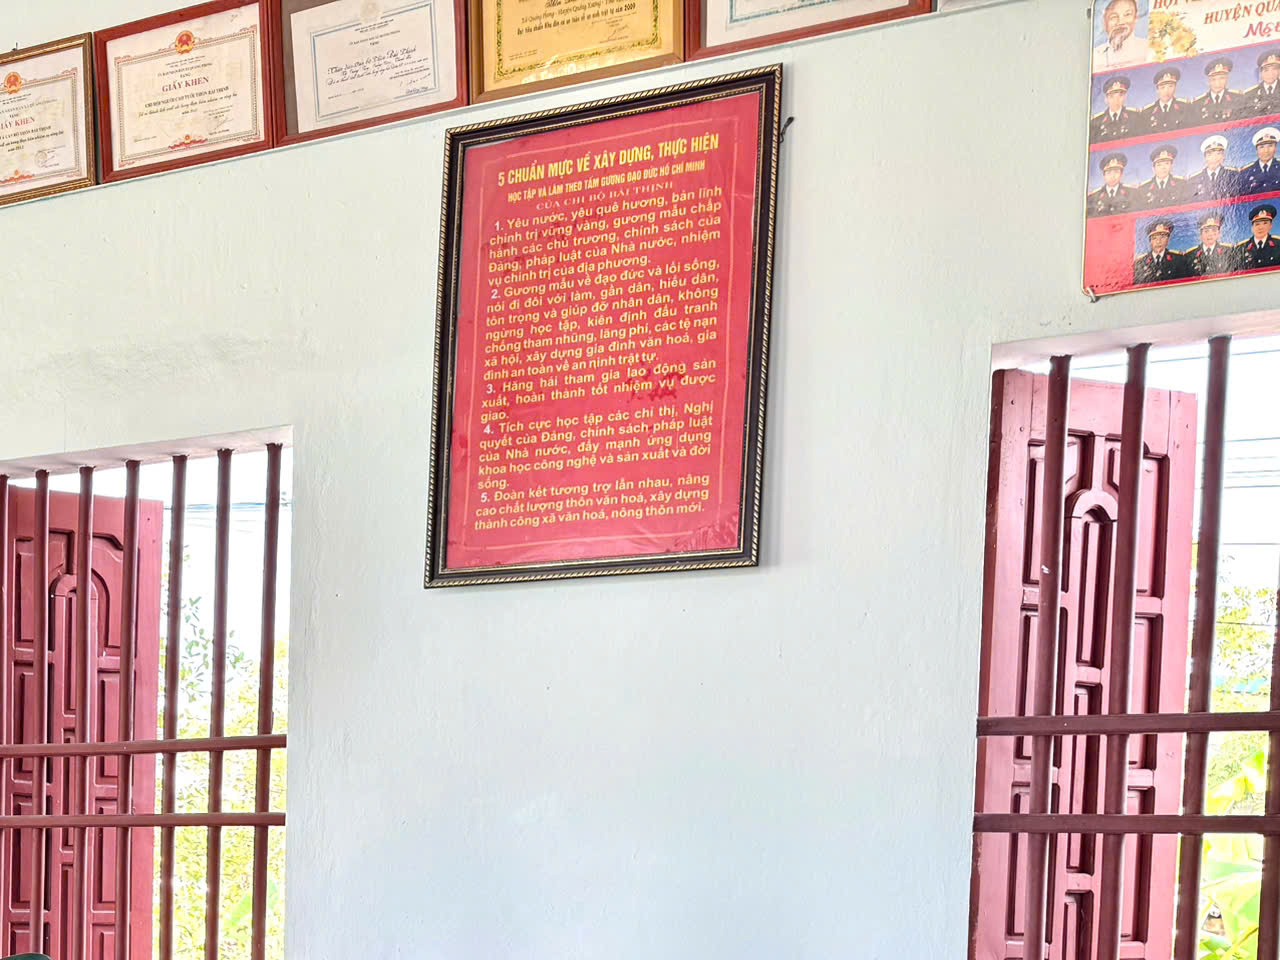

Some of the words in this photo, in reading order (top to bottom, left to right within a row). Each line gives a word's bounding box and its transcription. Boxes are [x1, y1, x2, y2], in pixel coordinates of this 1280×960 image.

[1203, 3, 1253, 24] HUYỆN
[162, 80, 182, 93] GIẤY
[184, 76, 210, 88] KHEN
[14, 116, 36, 127] KHEN
[497, 171, 505, 187] 5
[507, 159, 545, 185] CHUẨN
[547, 158, 574, 179] MỰC
[576, 151, 591, 173] VỀ
[593, 149, 617, 170] XÂY
[618, 144, 655, 166] DỰNG,
[657, 137, 688, 159] THỰC
[690, 131, 720, 154] HIỆN
[507, 191, 522, 204] HỌC
[523, 187, 537, 201] TẬP
[537, 185, 547, 198] VÀ
[547, 183, 564, 196] LÀM
[564, 180, 583, 193] THEO
[584, 177, 600, 190] TẤM
[600, 172, 626, 187] GƯƠNG
[626, 170, 642, 184] ĐẠO
[642, 167, 659, 180] ĐỨC
[659, 163, 670, 177] HỒ
[671, 161, 684, 175] CHÍ
[684, 159, 706, 173] MINH
[489, 231, 522, 246] chính
[525, 228, 538, 241] trị
[541, 224, 573, 237] vững
[576, 219, 609, 232] vàng,
[612, 211, 656, 229] gương
[659, 204, 687, 219] mẫu
[690, 198, 722, 214] chấp
[494, 220, 504, 231] 1.
[506, 217, 530, 229] Yêu
[532, 211, 568, 226] nước,
[570, 206, 593, 222] yêu
[595, 201, 619, 217] quê
[622, 196, 668, 211] hương,
[671, 189, 695, 203] bản
[698, 185, 723, 199] lĩnh
[488, 261, 522, 273] Đảng,
[525, 254, 556, 270] pháp
[559, 249, 582, 263] luật
[585, 245, 607, 259] của
[611, 241, 636, 255] Nhà
[639, 236, 677, 251] nước,
[681, 229, 721, 244] nhiệm
[489, 245, 518, 259] hành
[521, 242, 543, 254] các
[546, 236, 569, 251] chủ
[572, 232, 620, 247] trương,
[623, 223, 659, 239] chính
[663, 218, 694, 233] sách
[697, 215, 721, 227] của
[487, 277, 502, 288] vụ
[503, 270, 537, 284] chính
[538, 267, 551, 280] trị
[552, 264, 575, 277] của
[576, 261, 595, 277] địa
[597, 255, 652, 273] phương.
[481, 393, 510, 409] xuất,
[515, 391, 545, 405] hoàn
[550, 386, 586, 401] thành
[591, 382, 608, 396] tốt
[613, 379, 653, 394] nhiệm
[658, 378, 675, 390] vụ
[679, 373, 716, 387] được
[485, 383, 496, 395] 3.
[502, 381, 534, 393] Hăng
[539, 375, 558, 388] hái
[564, 373, 595, 385] tham
[601, 369, 621, 384] gia
[627, 367, 647, 378] lao
[652, 362, 687, 376] động
[692, 357, 717, 371] sản
[480, 411, 510, 425] giao.
[475, 507, 497, 517] cao
[498, 500, 525, 515] chất
[526, 500, 564, 513] lượng
[565, 496, 594, 508] thôn
[595, 494, 618, 506] văn
[620, 491, 647, 504] hoá,
[649, 490, 672, 504] xây
[674, 488, 709, 502] dựng
[480, 491, 491, 503] 5.
[493, 489, 525, 502] Đoàn
[528, 485, 548, 498] kết
[549, 484, 589, 496] tương
[592, 482, 612, 494] trợ
[615, 478, 634, 491] lẫn
[637, 476, 673, 489] nhau,
[677, 473, 710, 487] nâng
[474, 517, 508, 531] thành
[509, 515, 540, 528] công
[541, 512, 556, 524] xã
[557, 511, 581, 522] văn
[582, 508, 609, 521] hoá,
[611, 506, 643, 520] nông
[645, 504, 674, 517] thôn
[675, 501, 705, 514] mới.
